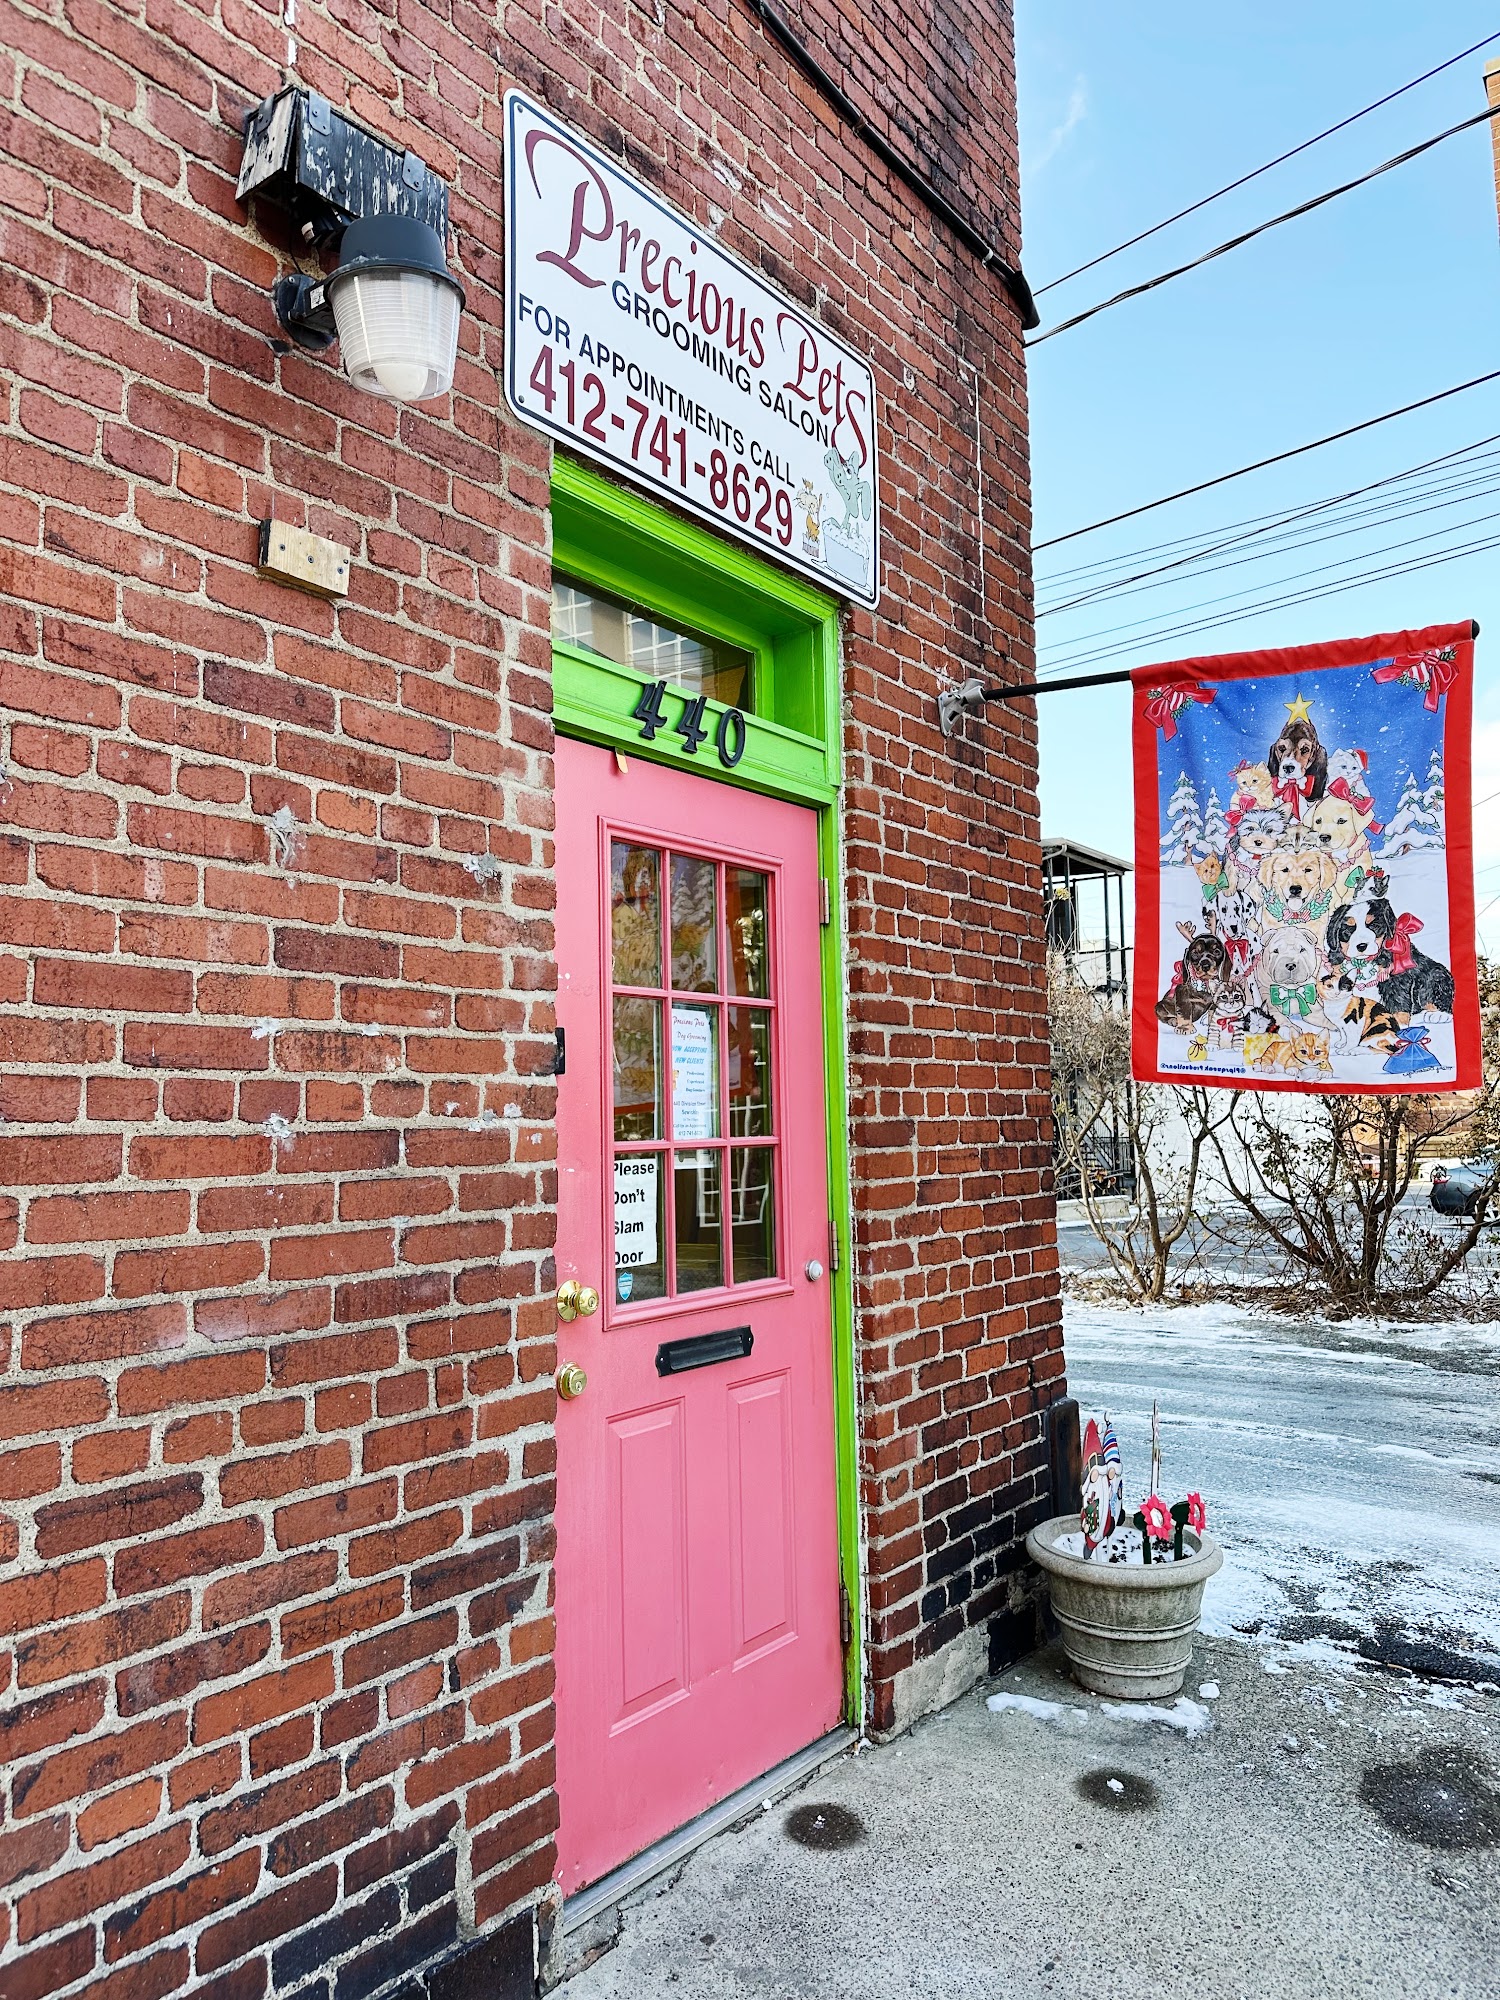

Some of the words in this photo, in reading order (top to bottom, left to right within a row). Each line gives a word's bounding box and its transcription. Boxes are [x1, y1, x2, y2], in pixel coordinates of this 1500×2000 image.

[525, 129, 765, 369] Precious
[518, 292, 571, 350] FOR
[578, 333, 745, 456] APPOINTMENTS
[750, 440, 796, 489] CALL
[529, 343, 793, 548] 412-741-8629
[611, 280, 751, 395] GROOMING
[759, 384, 829, 448] SALON
[634, 680, 746, 769] 440
[614, 1162, 655, 1176] Please
[614, 1220, 644, 1235] Slam
